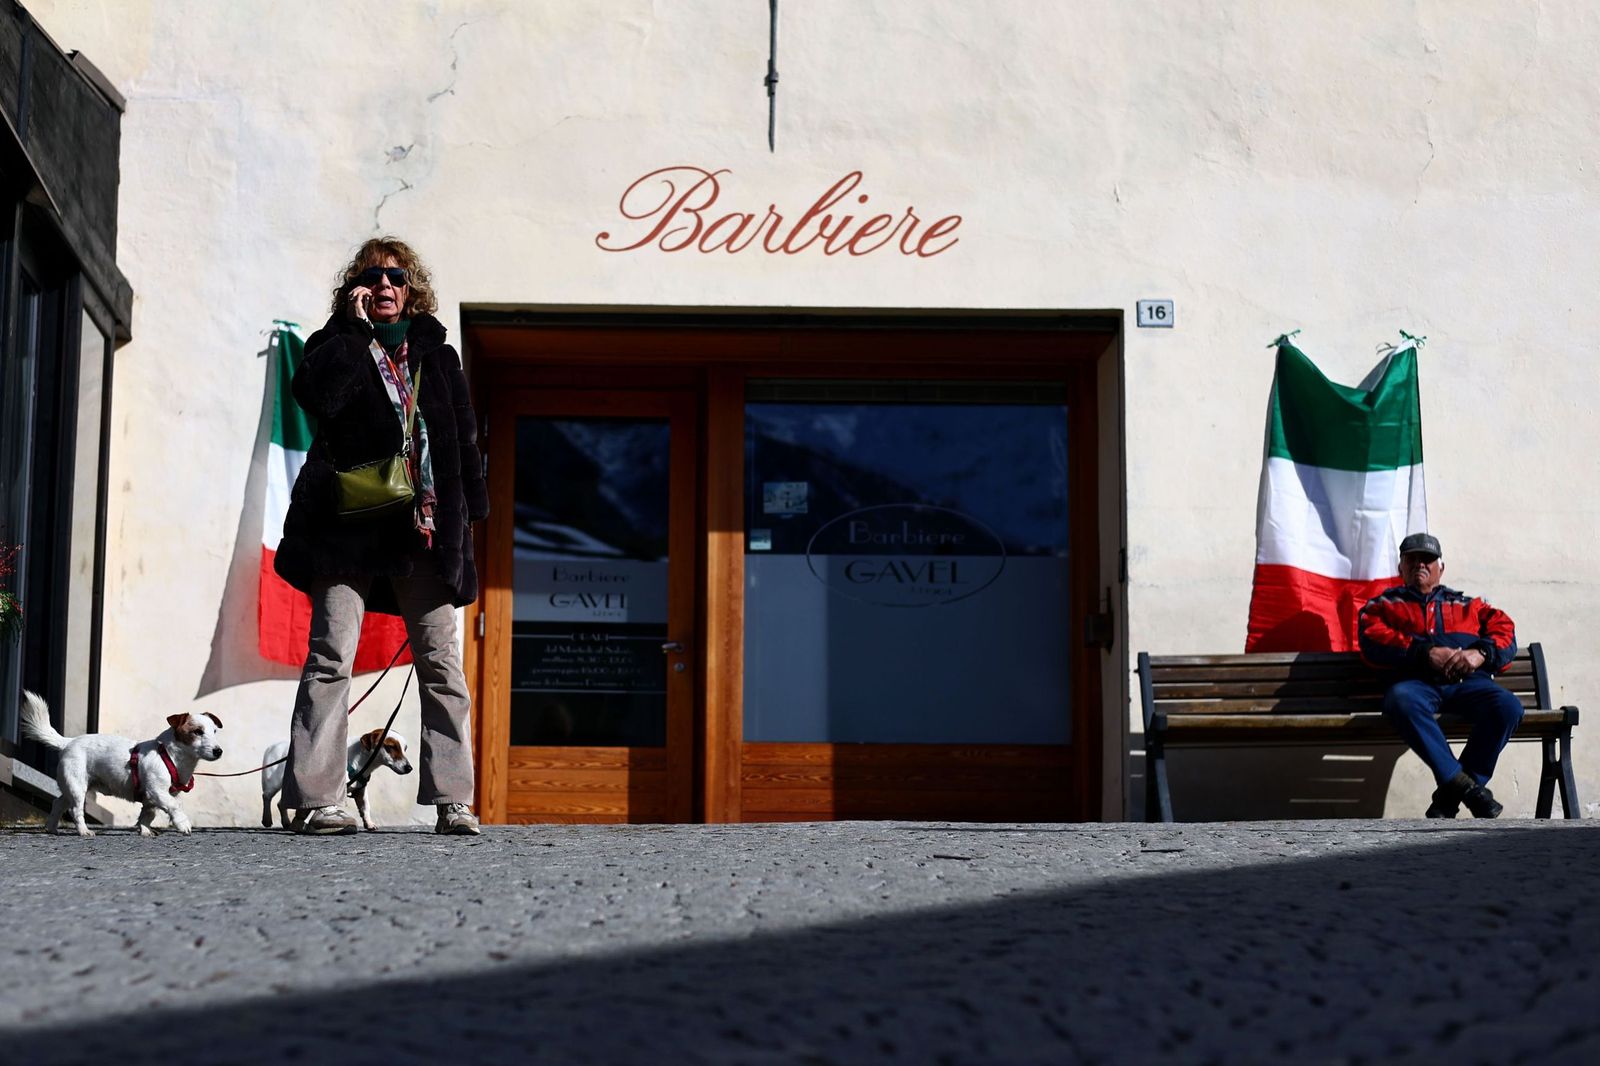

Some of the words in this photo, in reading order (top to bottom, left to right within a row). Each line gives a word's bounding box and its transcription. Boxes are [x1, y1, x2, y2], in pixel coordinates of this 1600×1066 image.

[595, 165, 962, 257] Barbiere
[1147, 305, 1166, 320] 16
[849, 520, 966, 544] Barbiere
[844, 560, 970, 584] GAVEL
